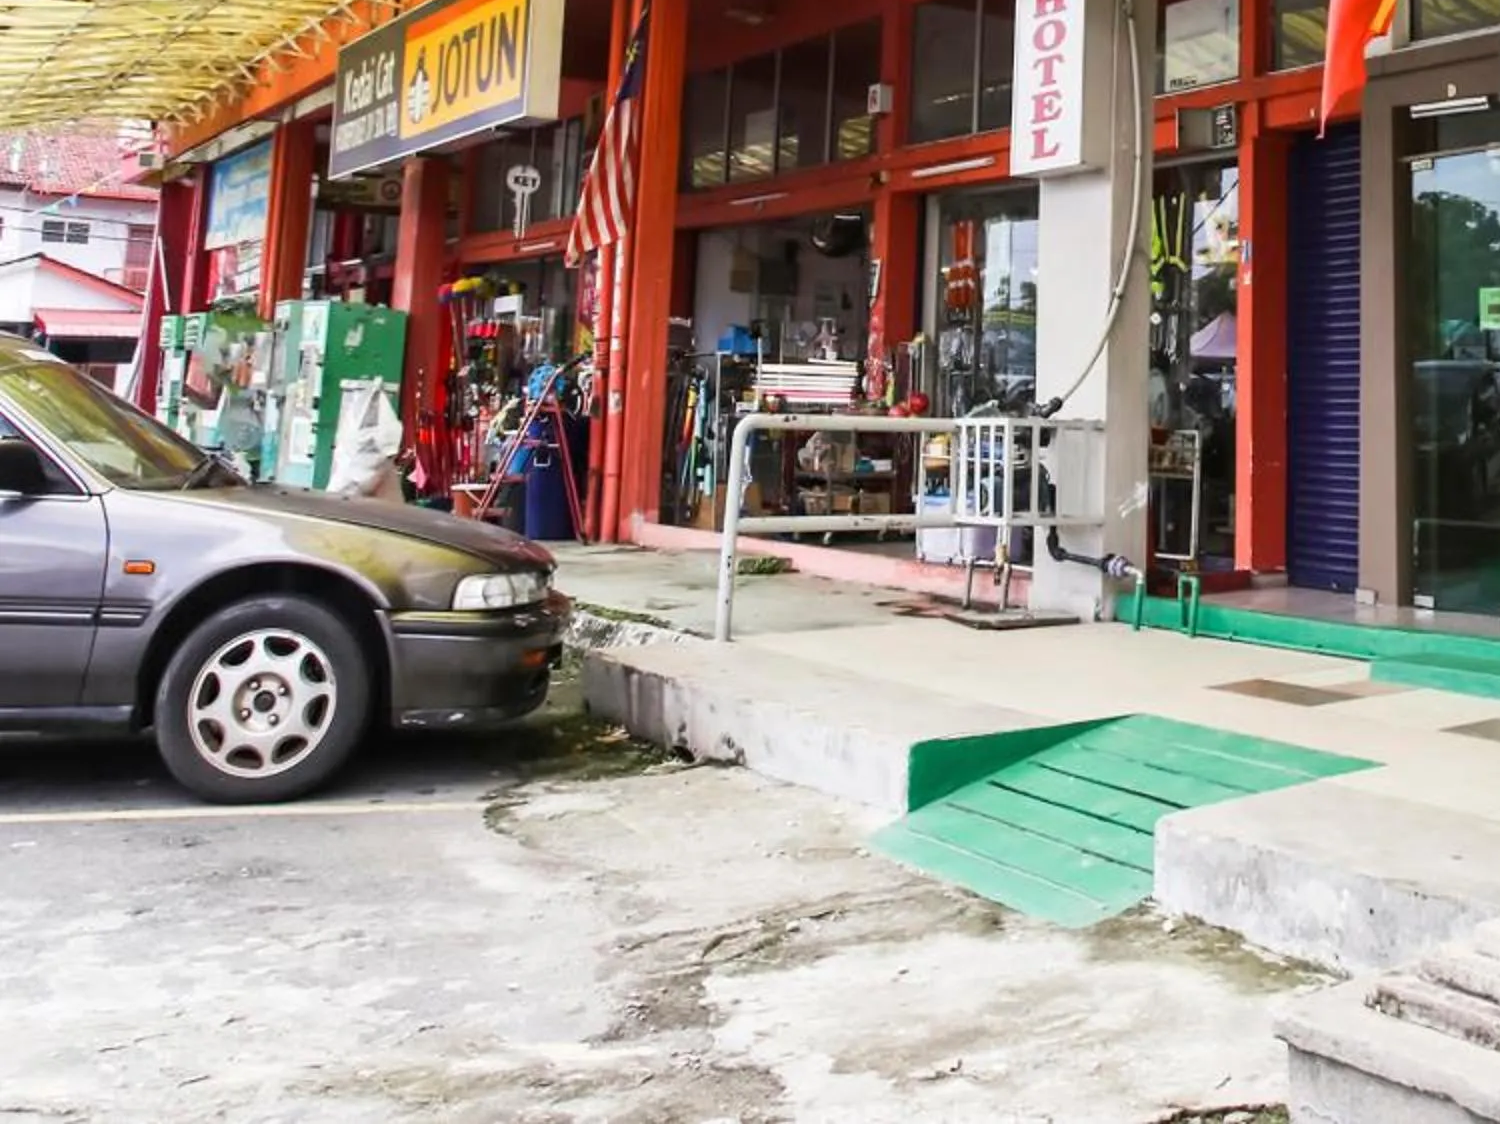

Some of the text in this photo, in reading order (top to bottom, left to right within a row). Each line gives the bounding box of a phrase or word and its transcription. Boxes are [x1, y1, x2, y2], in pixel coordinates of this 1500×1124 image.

[343, 50, 395, 115] Kedai Cat
[431, 5, 520, 115] JOTUN
